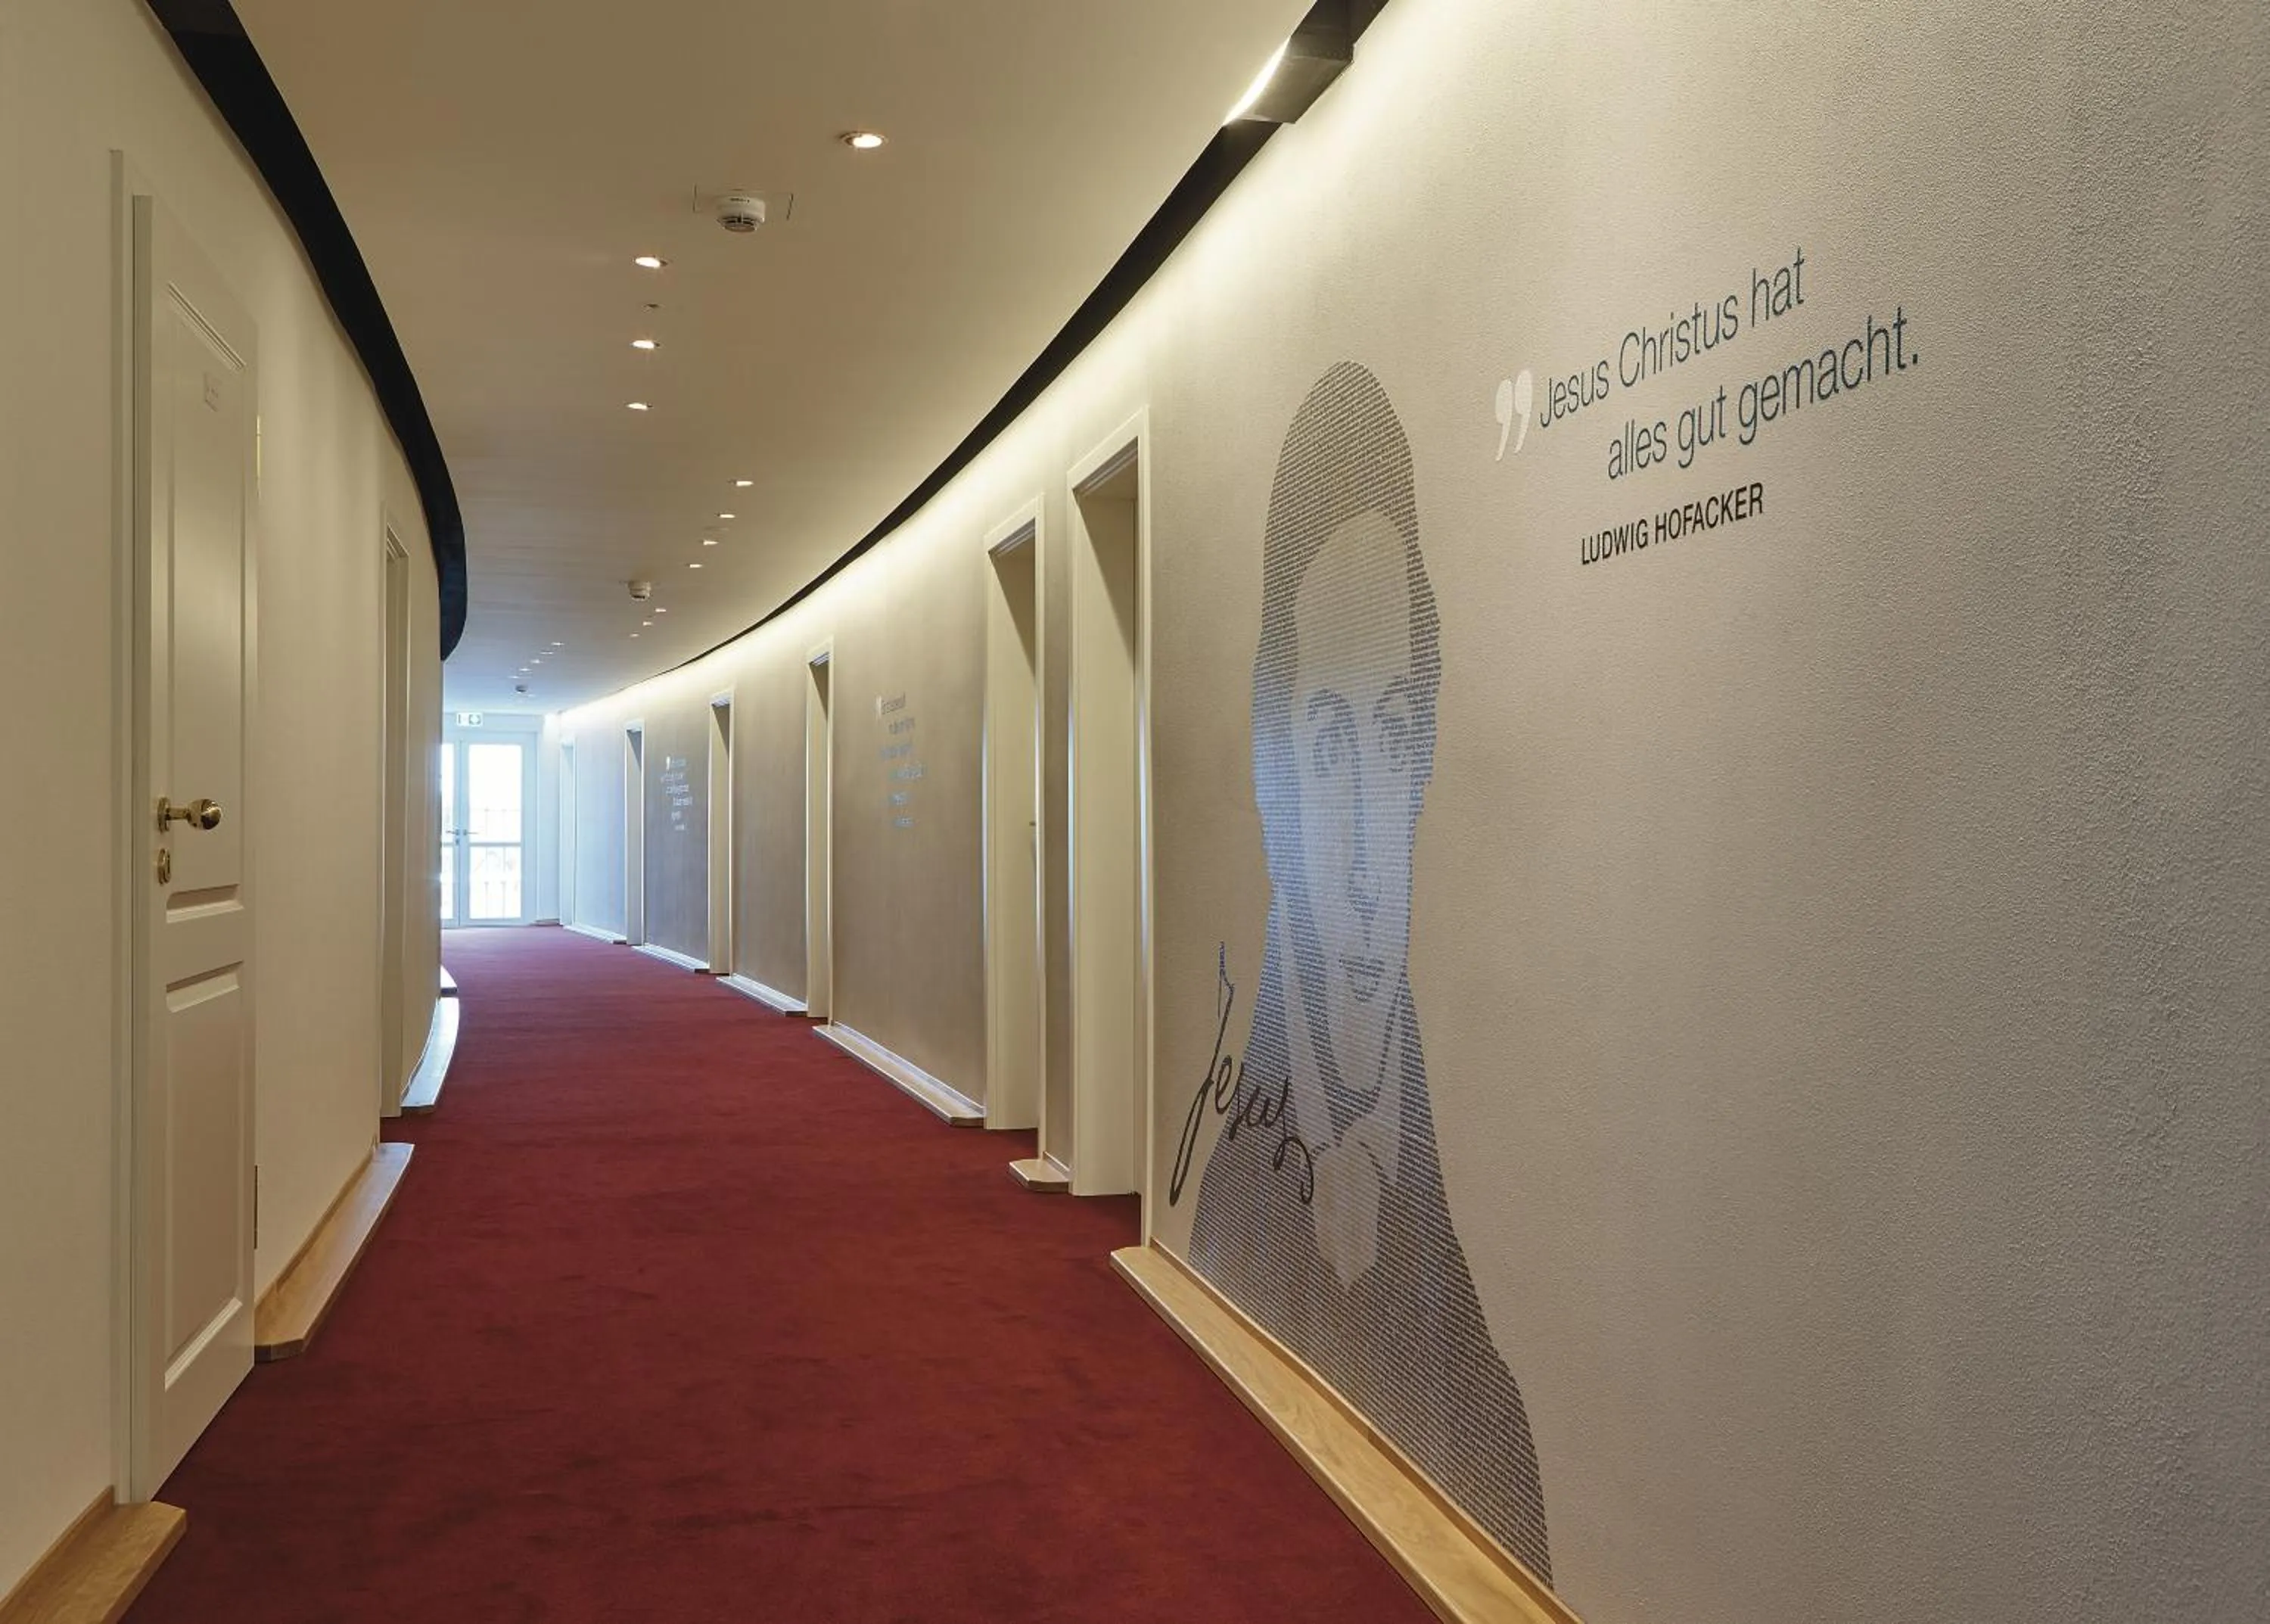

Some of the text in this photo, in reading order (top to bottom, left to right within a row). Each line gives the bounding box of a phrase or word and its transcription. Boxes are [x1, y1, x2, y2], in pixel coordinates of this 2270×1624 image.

[1539, 247, 1805, 428] Jesus Christus hat
[1608, 306, 1918, 480] alles gut gemacht.
[1581, 482, 1763, 565] LUDWIG HOFACKER
